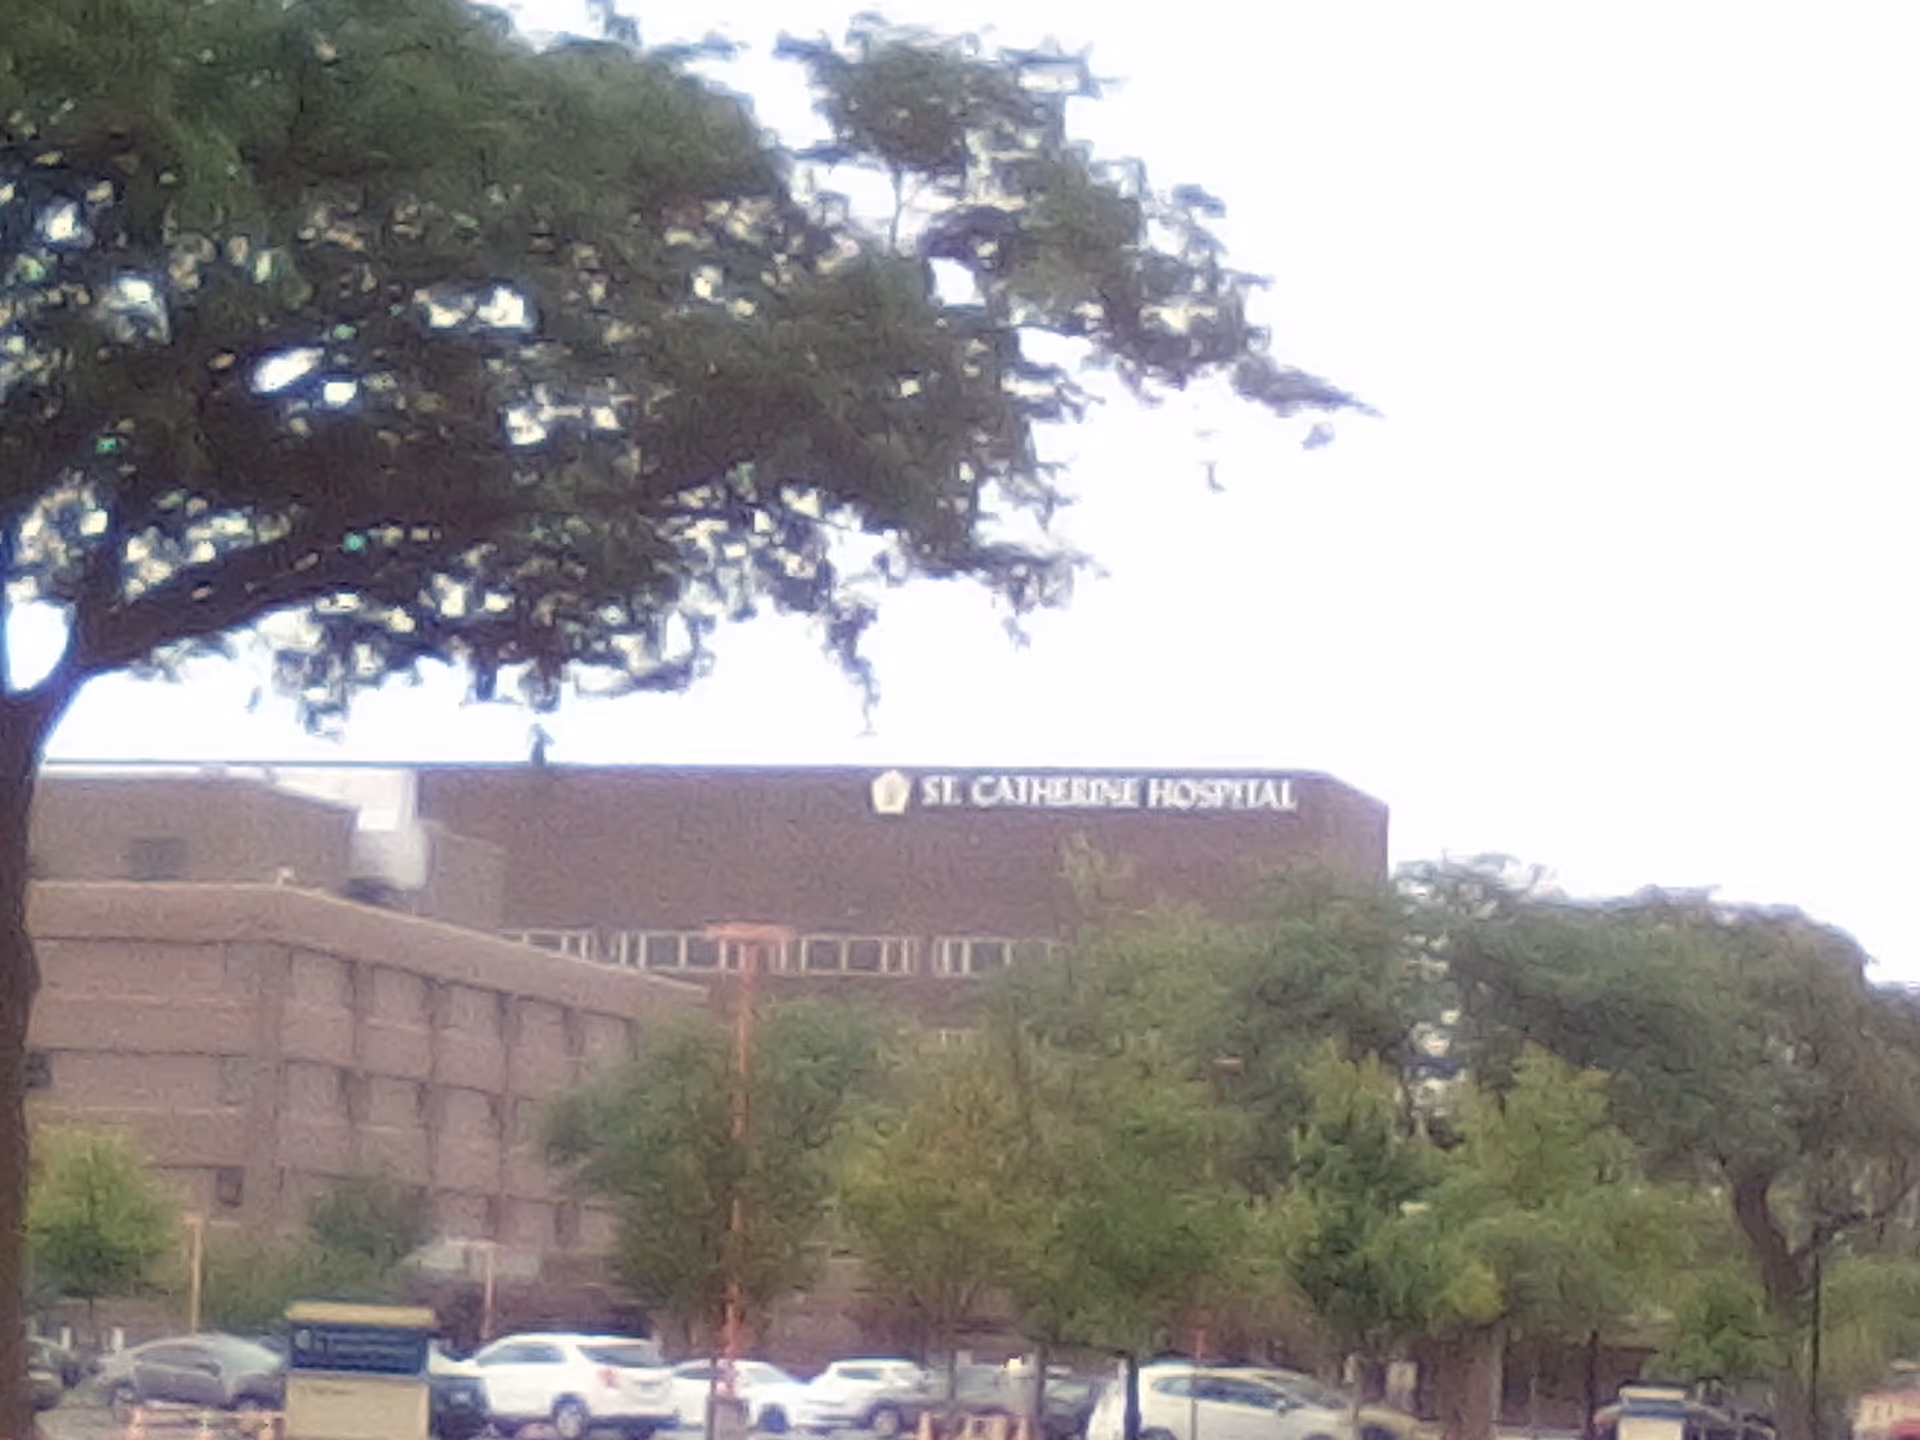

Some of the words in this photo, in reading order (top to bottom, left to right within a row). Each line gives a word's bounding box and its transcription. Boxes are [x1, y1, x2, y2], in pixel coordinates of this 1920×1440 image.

[920, 775, 961, 806] ST.
[971, 775, 1137, 808] CATHERINE
[1147, 778, 1297, 811] HOSPITAL
